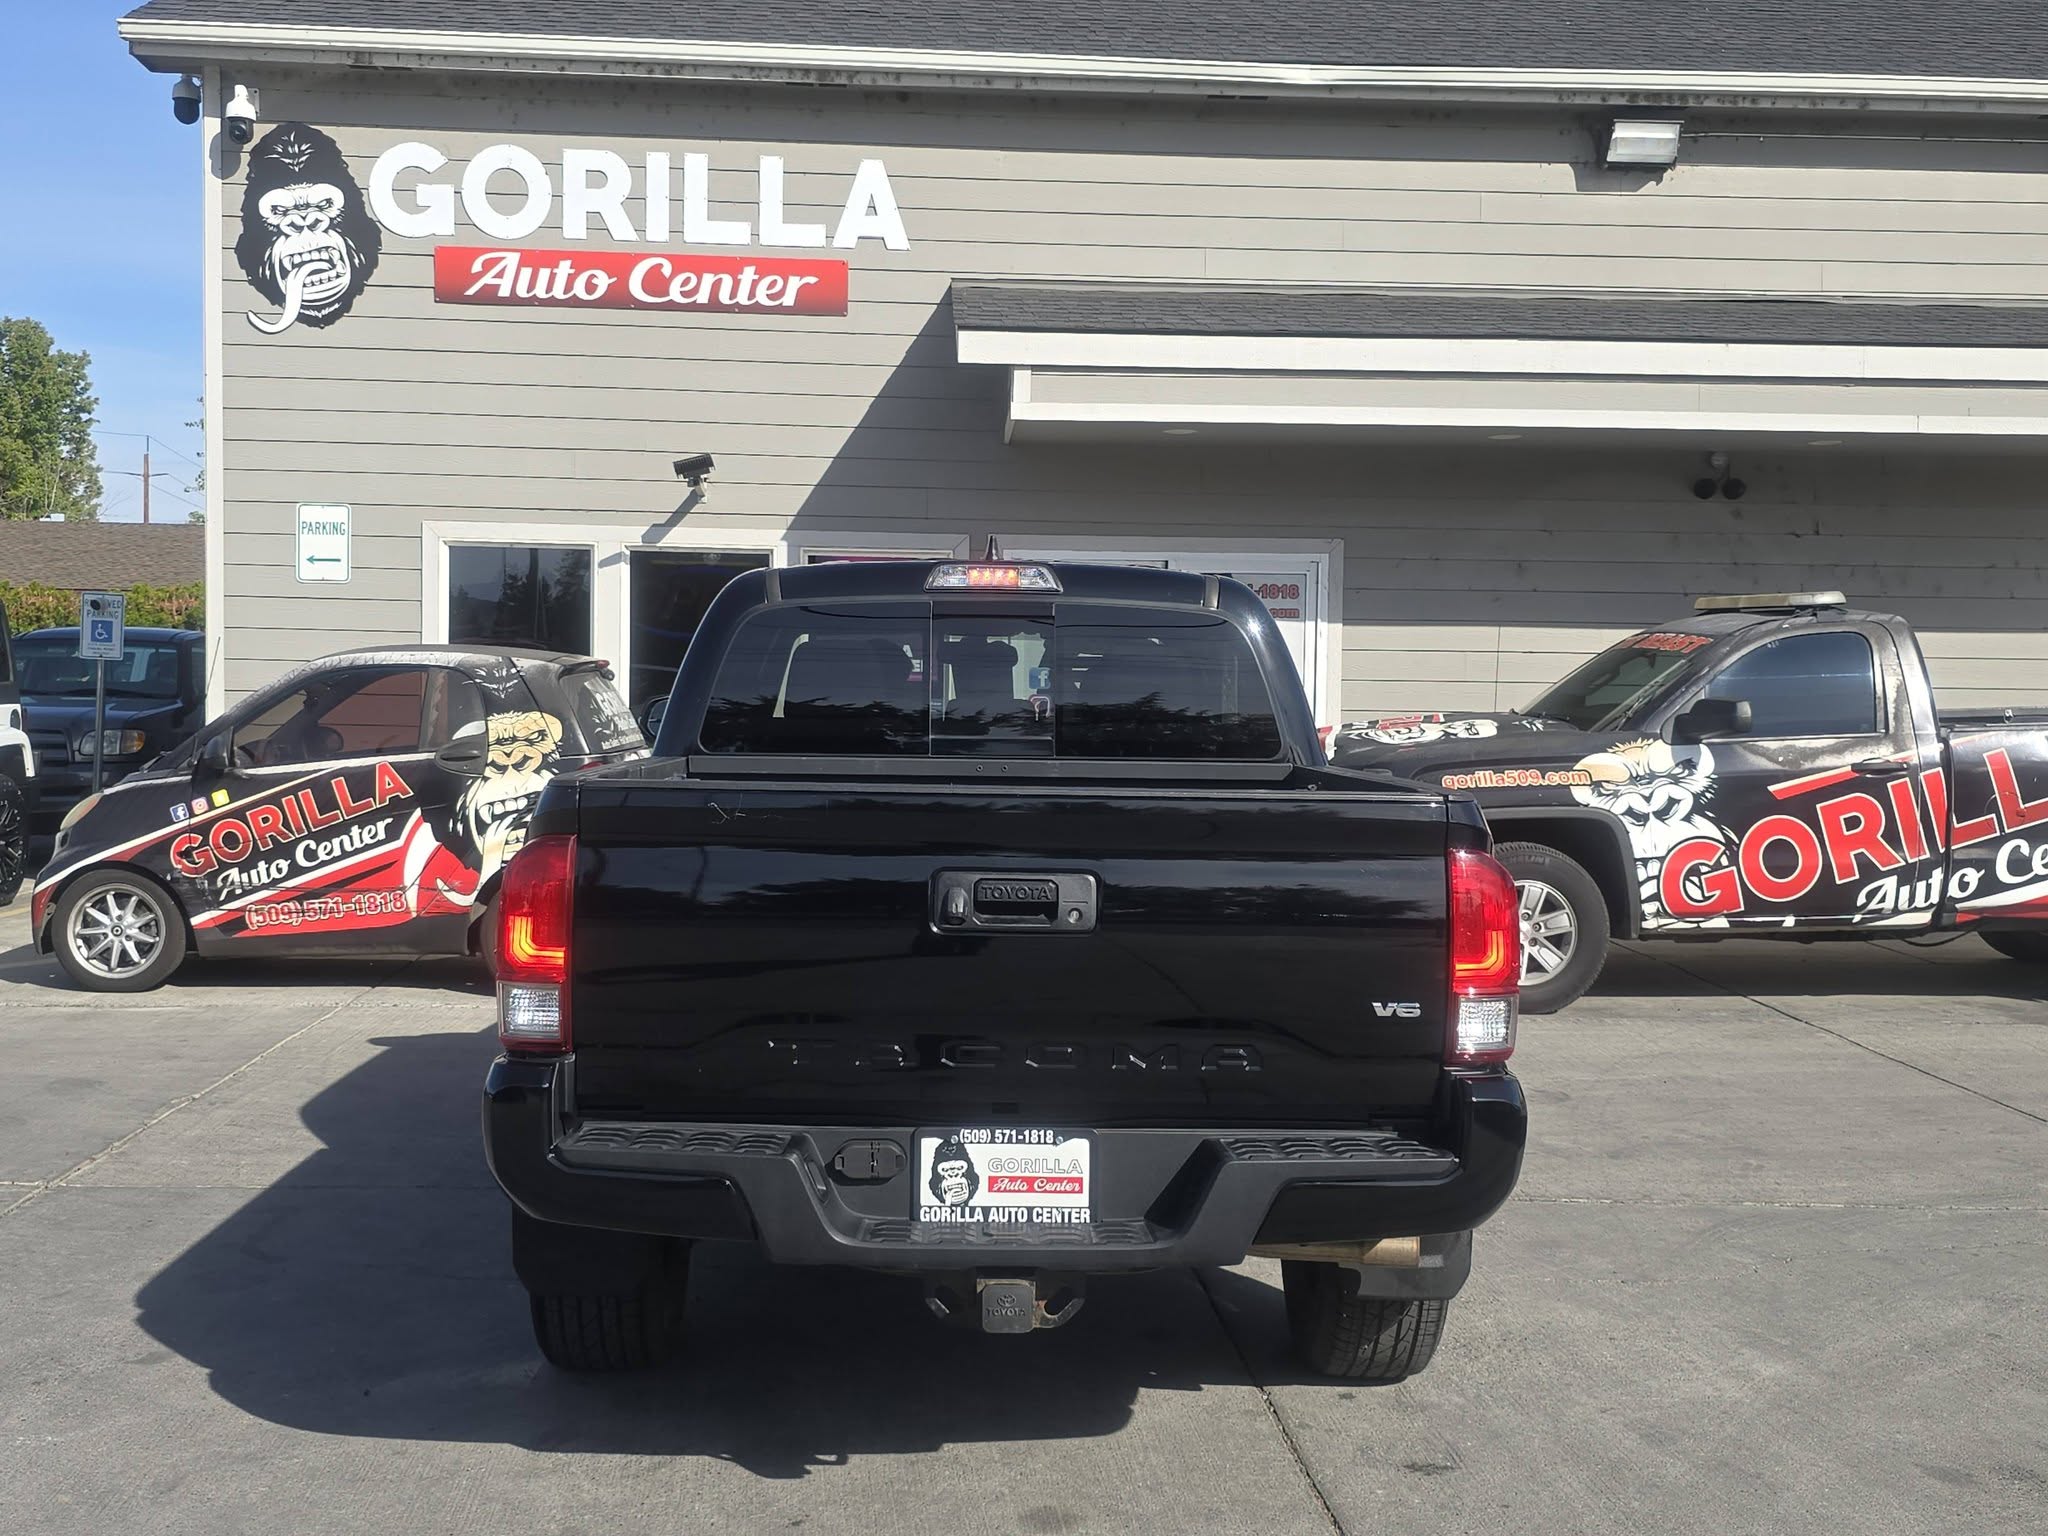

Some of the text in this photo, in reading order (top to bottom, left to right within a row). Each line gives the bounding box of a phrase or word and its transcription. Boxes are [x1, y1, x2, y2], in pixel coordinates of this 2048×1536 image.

[368, 141, 911, 251] GORILLA
[463, 251, 819, 308] Auto Center
[301, 521, 346, 536] PARKING
[86, 609, 120, 619] PARKING
[1442, 769, 1591, 790] gorilla509.com
[170, 761, 414, 877] GORILLA
[216, 817, 394, 901] Auto Center
[981, 885, 1052, 900] TOYOTA
[1852, 866, 1985, 923] Auto
[1371, 1002, 1421, 1018] V6
[959, 1128, 1054, 1144] (509) 571-1818
[988, 1158, 1083, 1174] GORILLA
[992, 1178, 1081, 1192] Auto Center
[920, 1206, 1091, 1224] GORILLA AUTO CENTER
